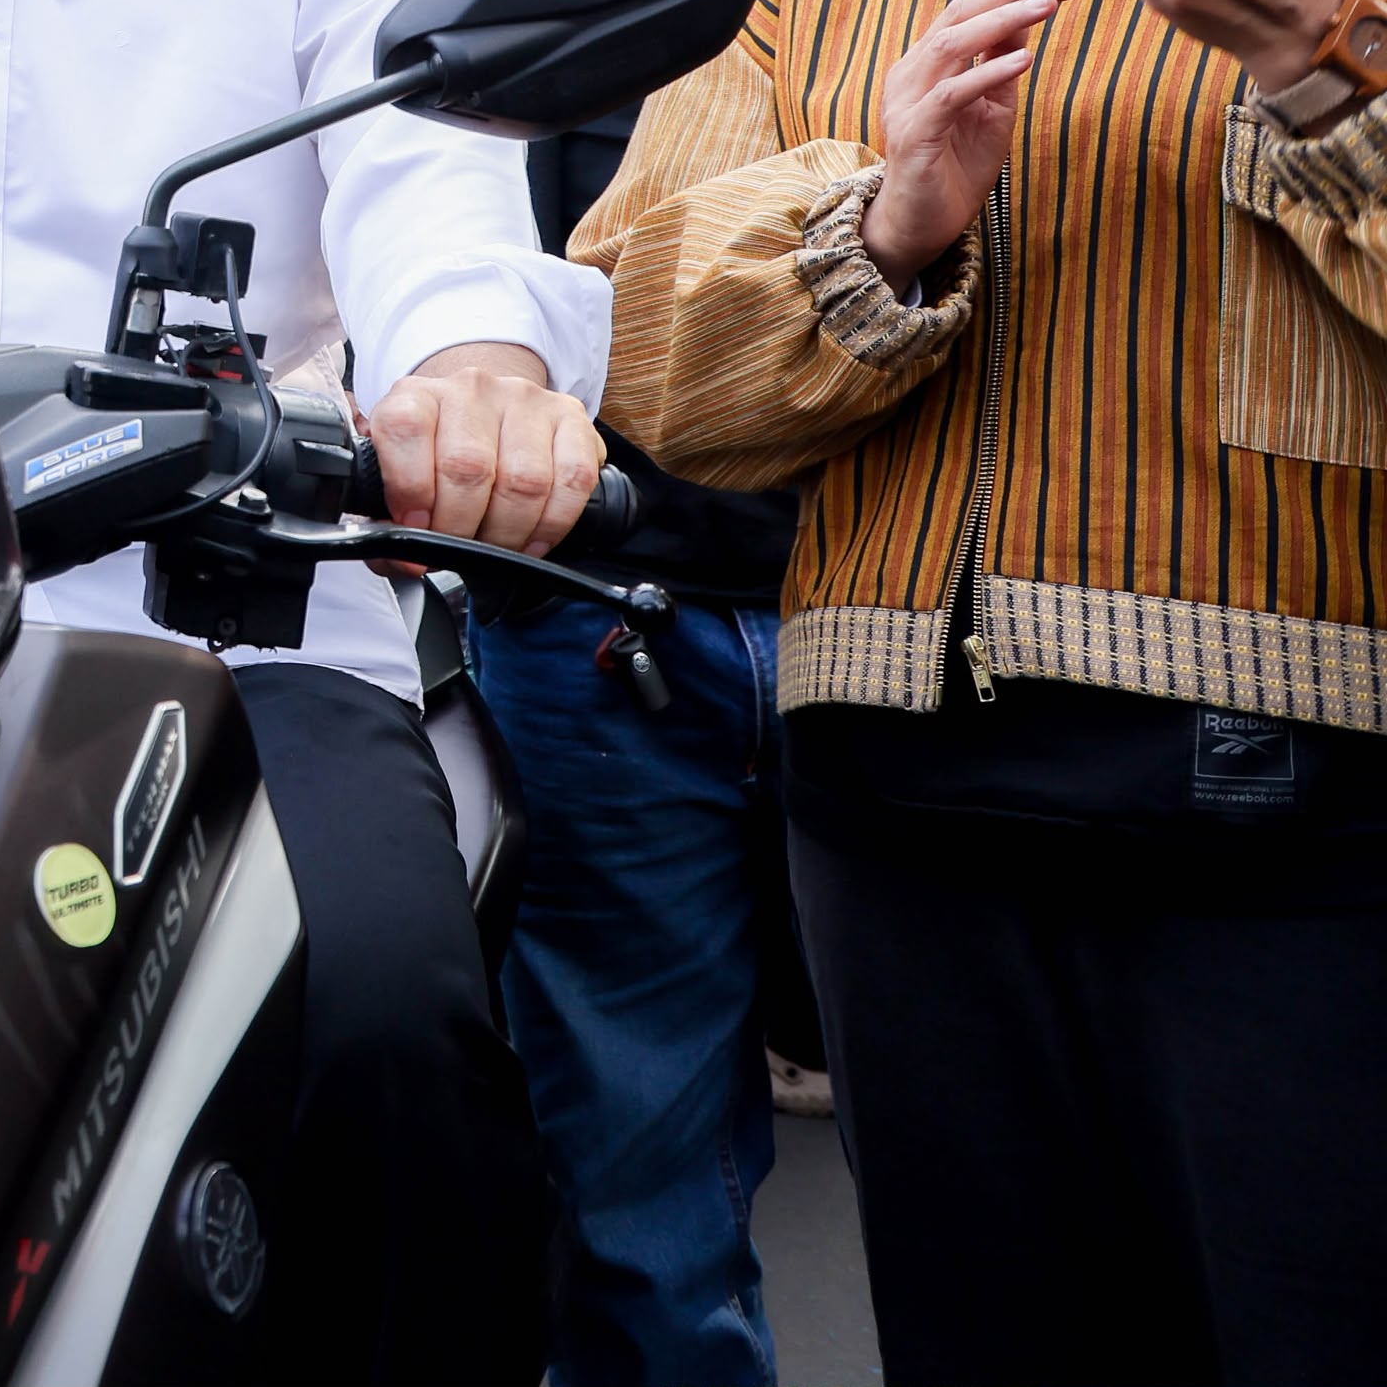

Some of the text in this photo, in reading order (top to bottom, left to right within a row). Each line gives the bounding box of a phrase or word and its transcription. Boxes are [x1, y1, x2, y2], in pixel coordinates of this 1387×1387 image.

[42, 427, 125, 469] BLUE
[43, 444, 124, 485] CORE
[48, 874, 99, 902] TURBO
[53, 894, 104, 920] ULTIMATE
[52, 816, 208, 1224] MITSUBISHI
